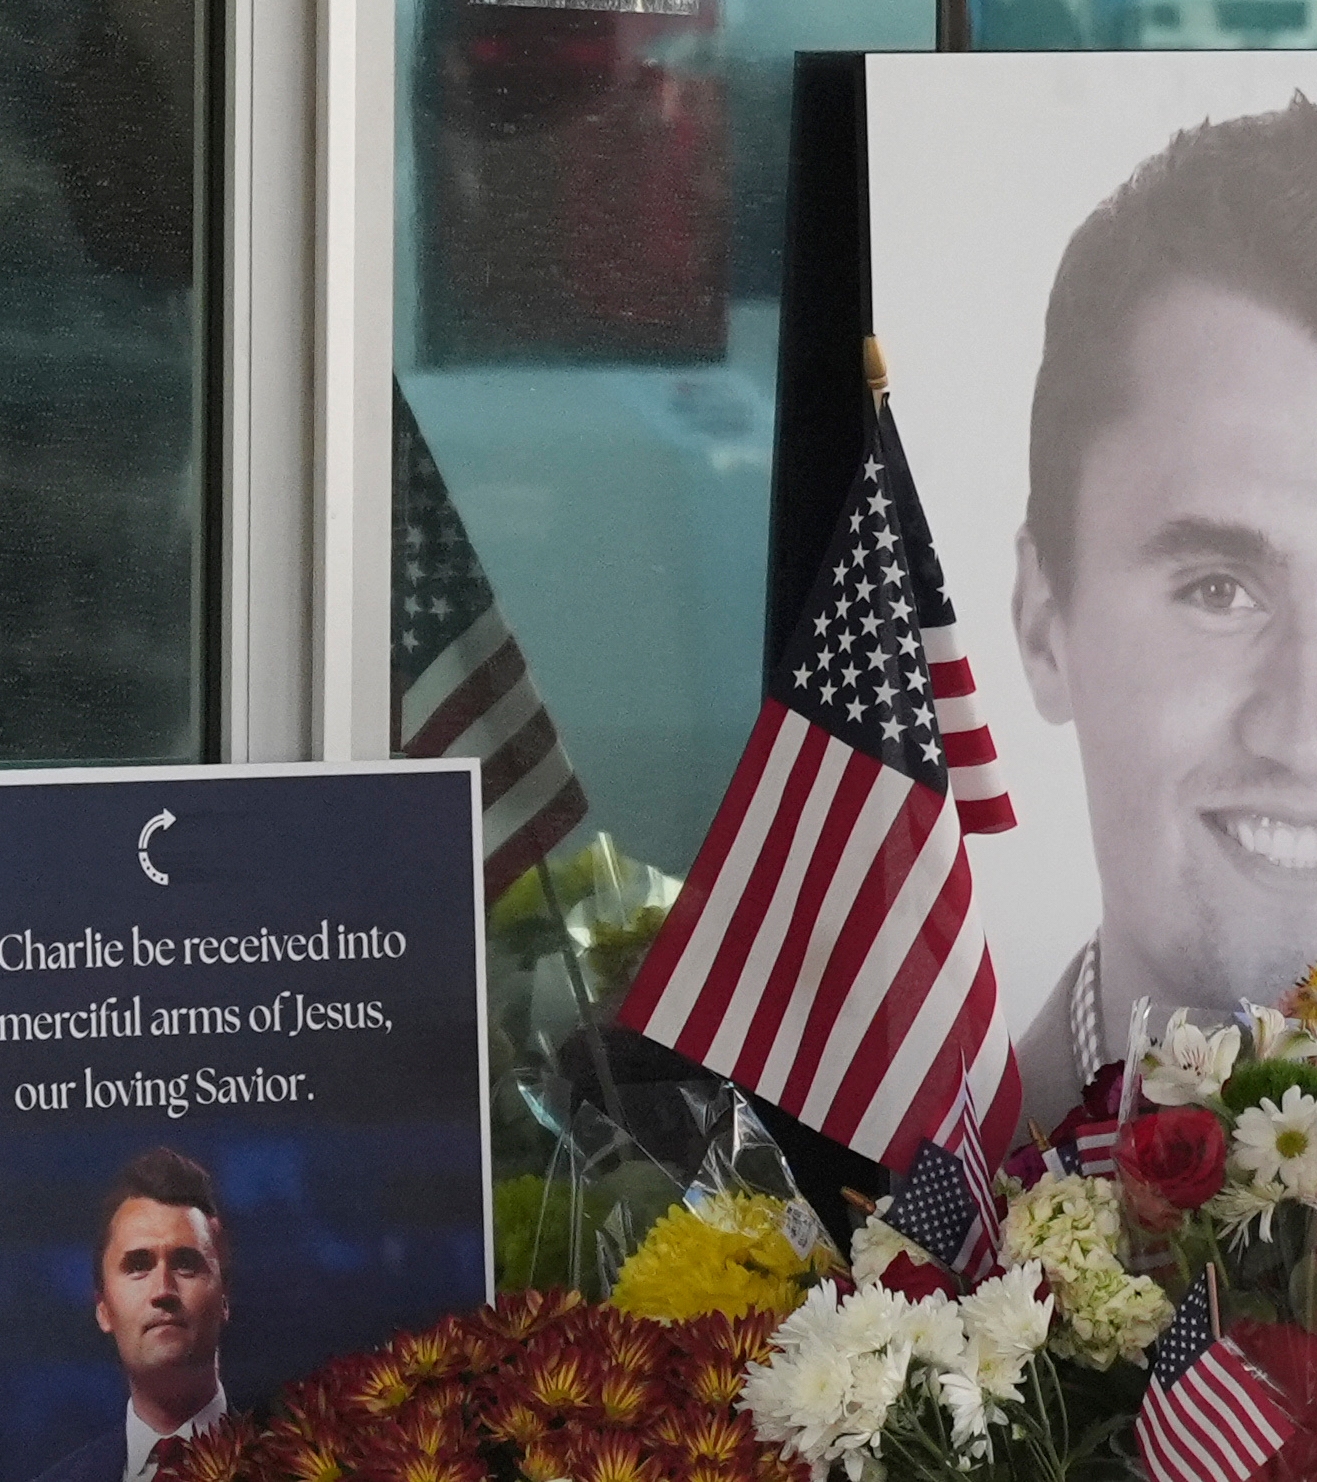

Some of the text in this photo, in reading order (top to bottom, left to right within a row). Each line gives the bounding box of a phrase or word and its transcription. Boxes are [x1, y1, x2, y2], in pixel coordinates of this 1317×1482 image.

[0, 919, 407, 971] Charlie be received into
[0, 990, 393, 1041] merciful arms of Jesus,
[14, 1067, 315, 1119] our loving Savior.
